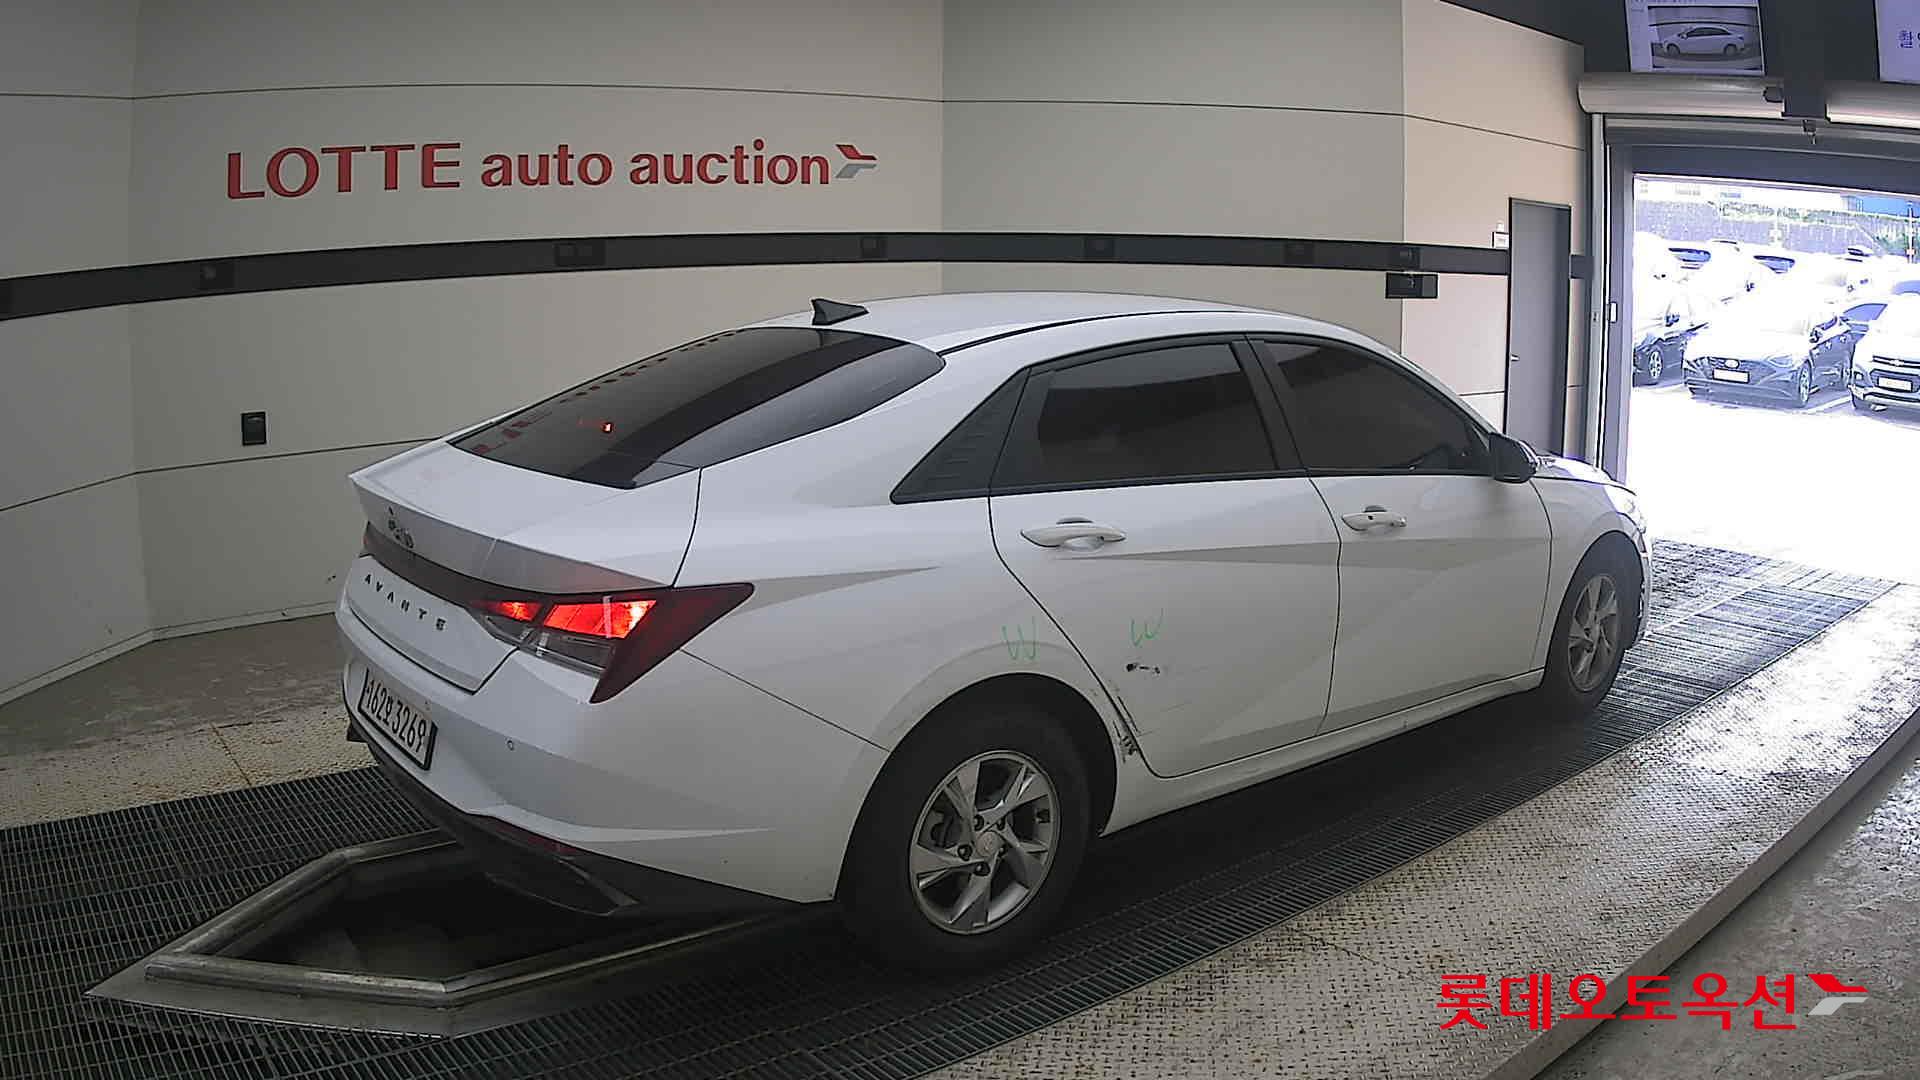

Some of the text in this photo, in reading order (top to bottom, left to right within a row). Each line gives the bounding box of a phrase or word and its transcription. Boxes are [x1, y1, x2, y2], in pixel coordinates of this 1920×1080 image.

[227, 139, 831, 199] LOTTE auto auction
[364, 574, 447, 631] AVANTE
